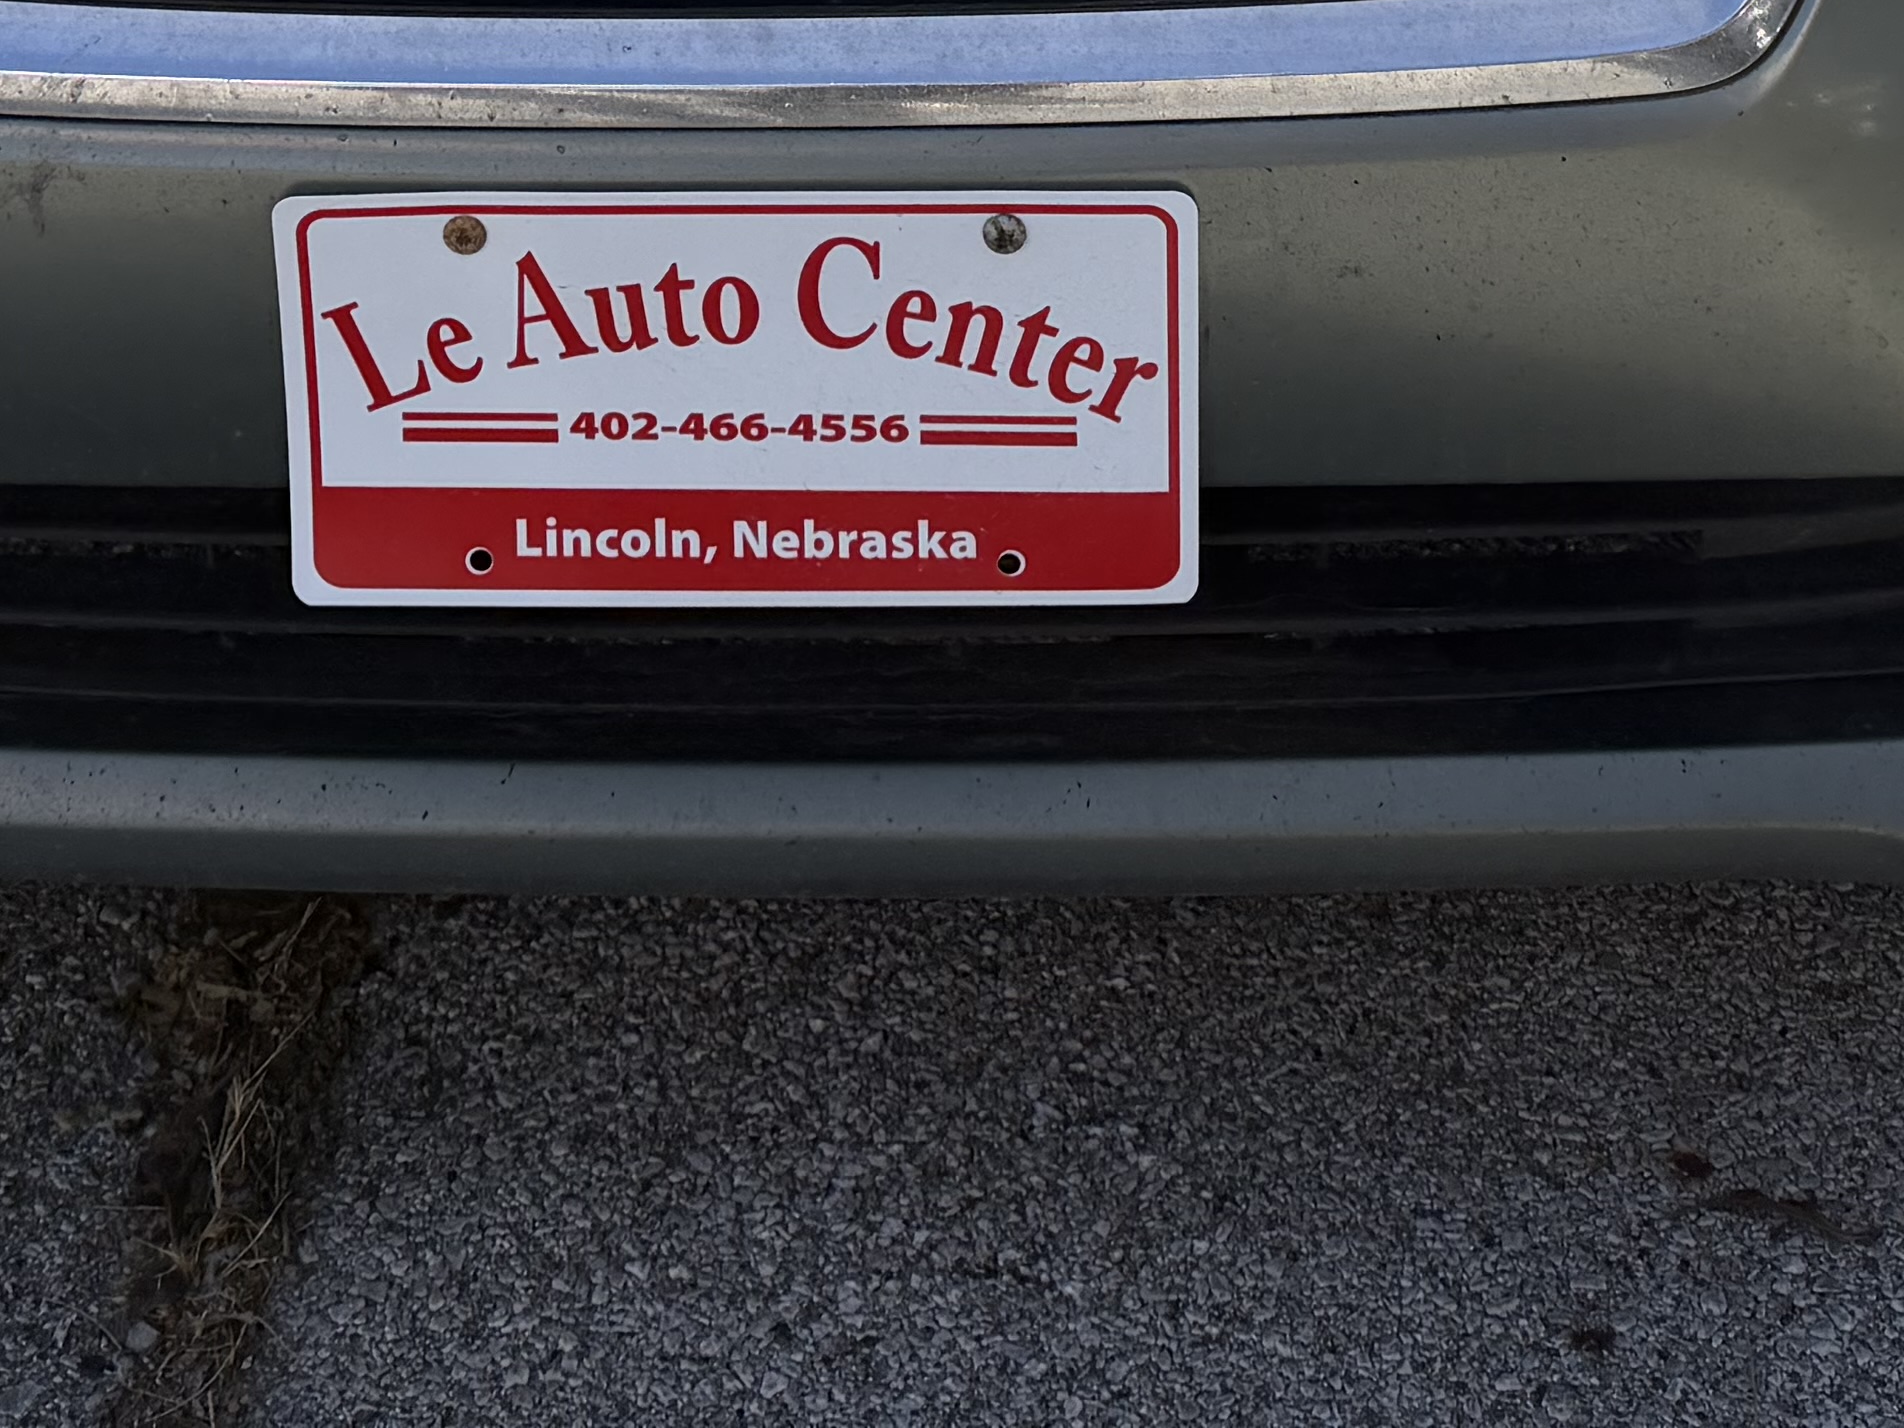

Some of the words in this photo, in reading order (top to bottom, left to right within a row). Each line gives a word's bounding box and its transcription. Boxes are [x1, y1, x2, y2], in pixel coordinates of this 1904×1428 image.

[321, 301, 484, 412] Le
[507, 250, 761, 369] Auto
[797, 236, 1160, 423] Center
[569, 411, 911, 443] 402-466-4556
[514, 516, 718, 564] Lincoln,
[732, 517, 978, 560] Nebraska
